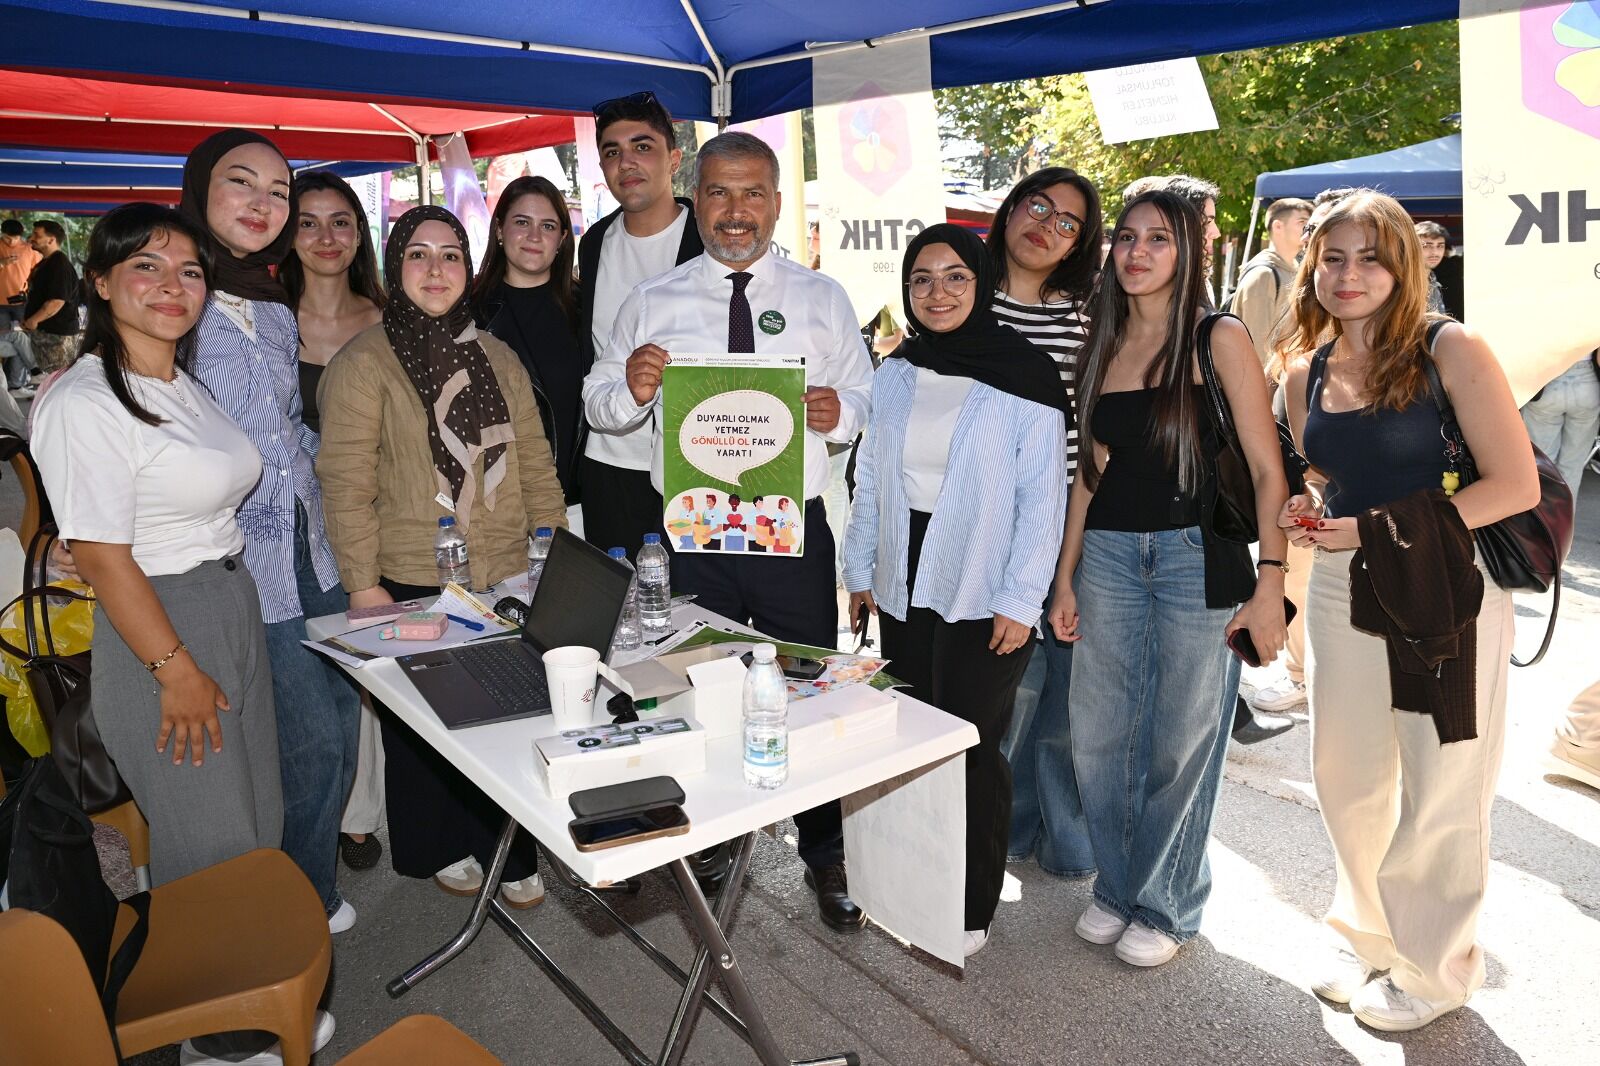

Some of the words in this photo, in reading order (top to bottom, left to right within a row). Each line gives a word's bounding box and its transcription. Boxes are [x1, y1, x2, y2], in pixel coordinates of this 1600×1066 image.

[696, 414, 736, 423] DUYARLI
[737, 415, 770, 424] OLMAK
[715, 426, 750, 435] YETMEZ
[691, 435, 735, 445] GÖNÜLLÜ
[737, 437, 750, 446] OL
[752, 438, 776, 446] FARK
